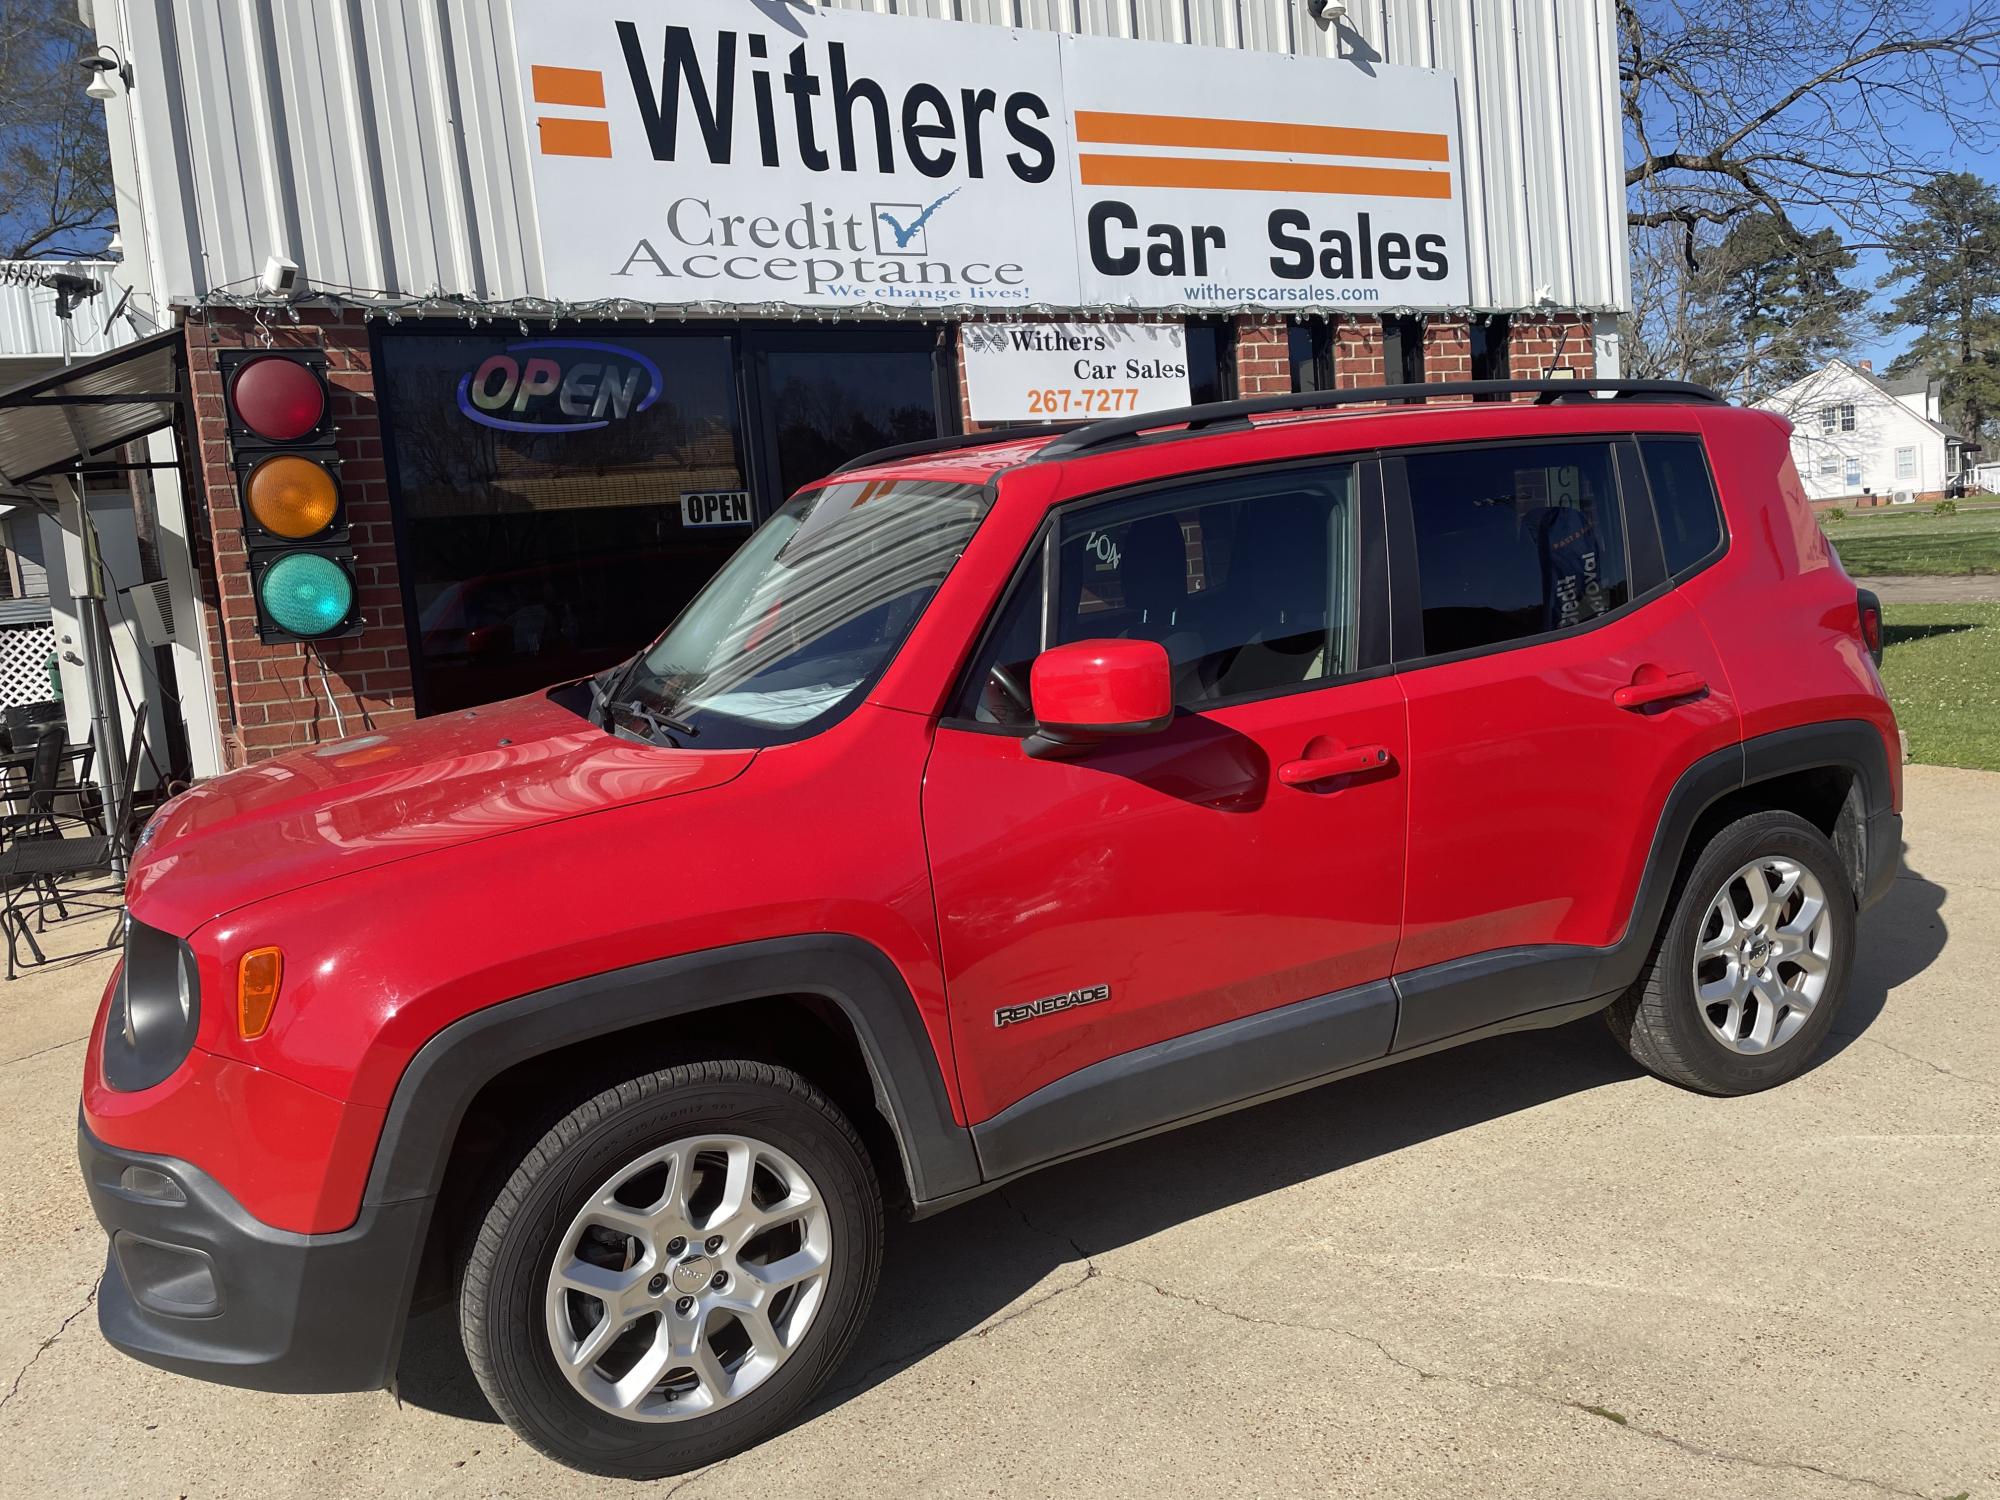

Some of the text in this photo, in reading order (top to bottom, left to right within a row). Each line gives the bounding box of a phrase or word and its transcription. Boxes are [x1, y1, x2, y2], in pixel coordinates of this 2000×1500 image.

[614, 19, 1057, 184] Withers
[666, 196, 868, 254] Credit
[1087, 200, 1449, 281] Car Sales
[610, 238, 1025, 296] Acceptance
[825, 284, 1031, 302] We change lives!
[1183, 283, 1379, 302] witherscarsales.com
[1009, 330, 1106, 352] Withers
[471, 354, 642, 420] OPEN
[1073, 358, 1186, 380] Car Sales
[1027, 388, 1140, 414] 267-7277
[687, 493, 748, 524] OPEN
[993, 984, 1110, 1028] RENEGADE
